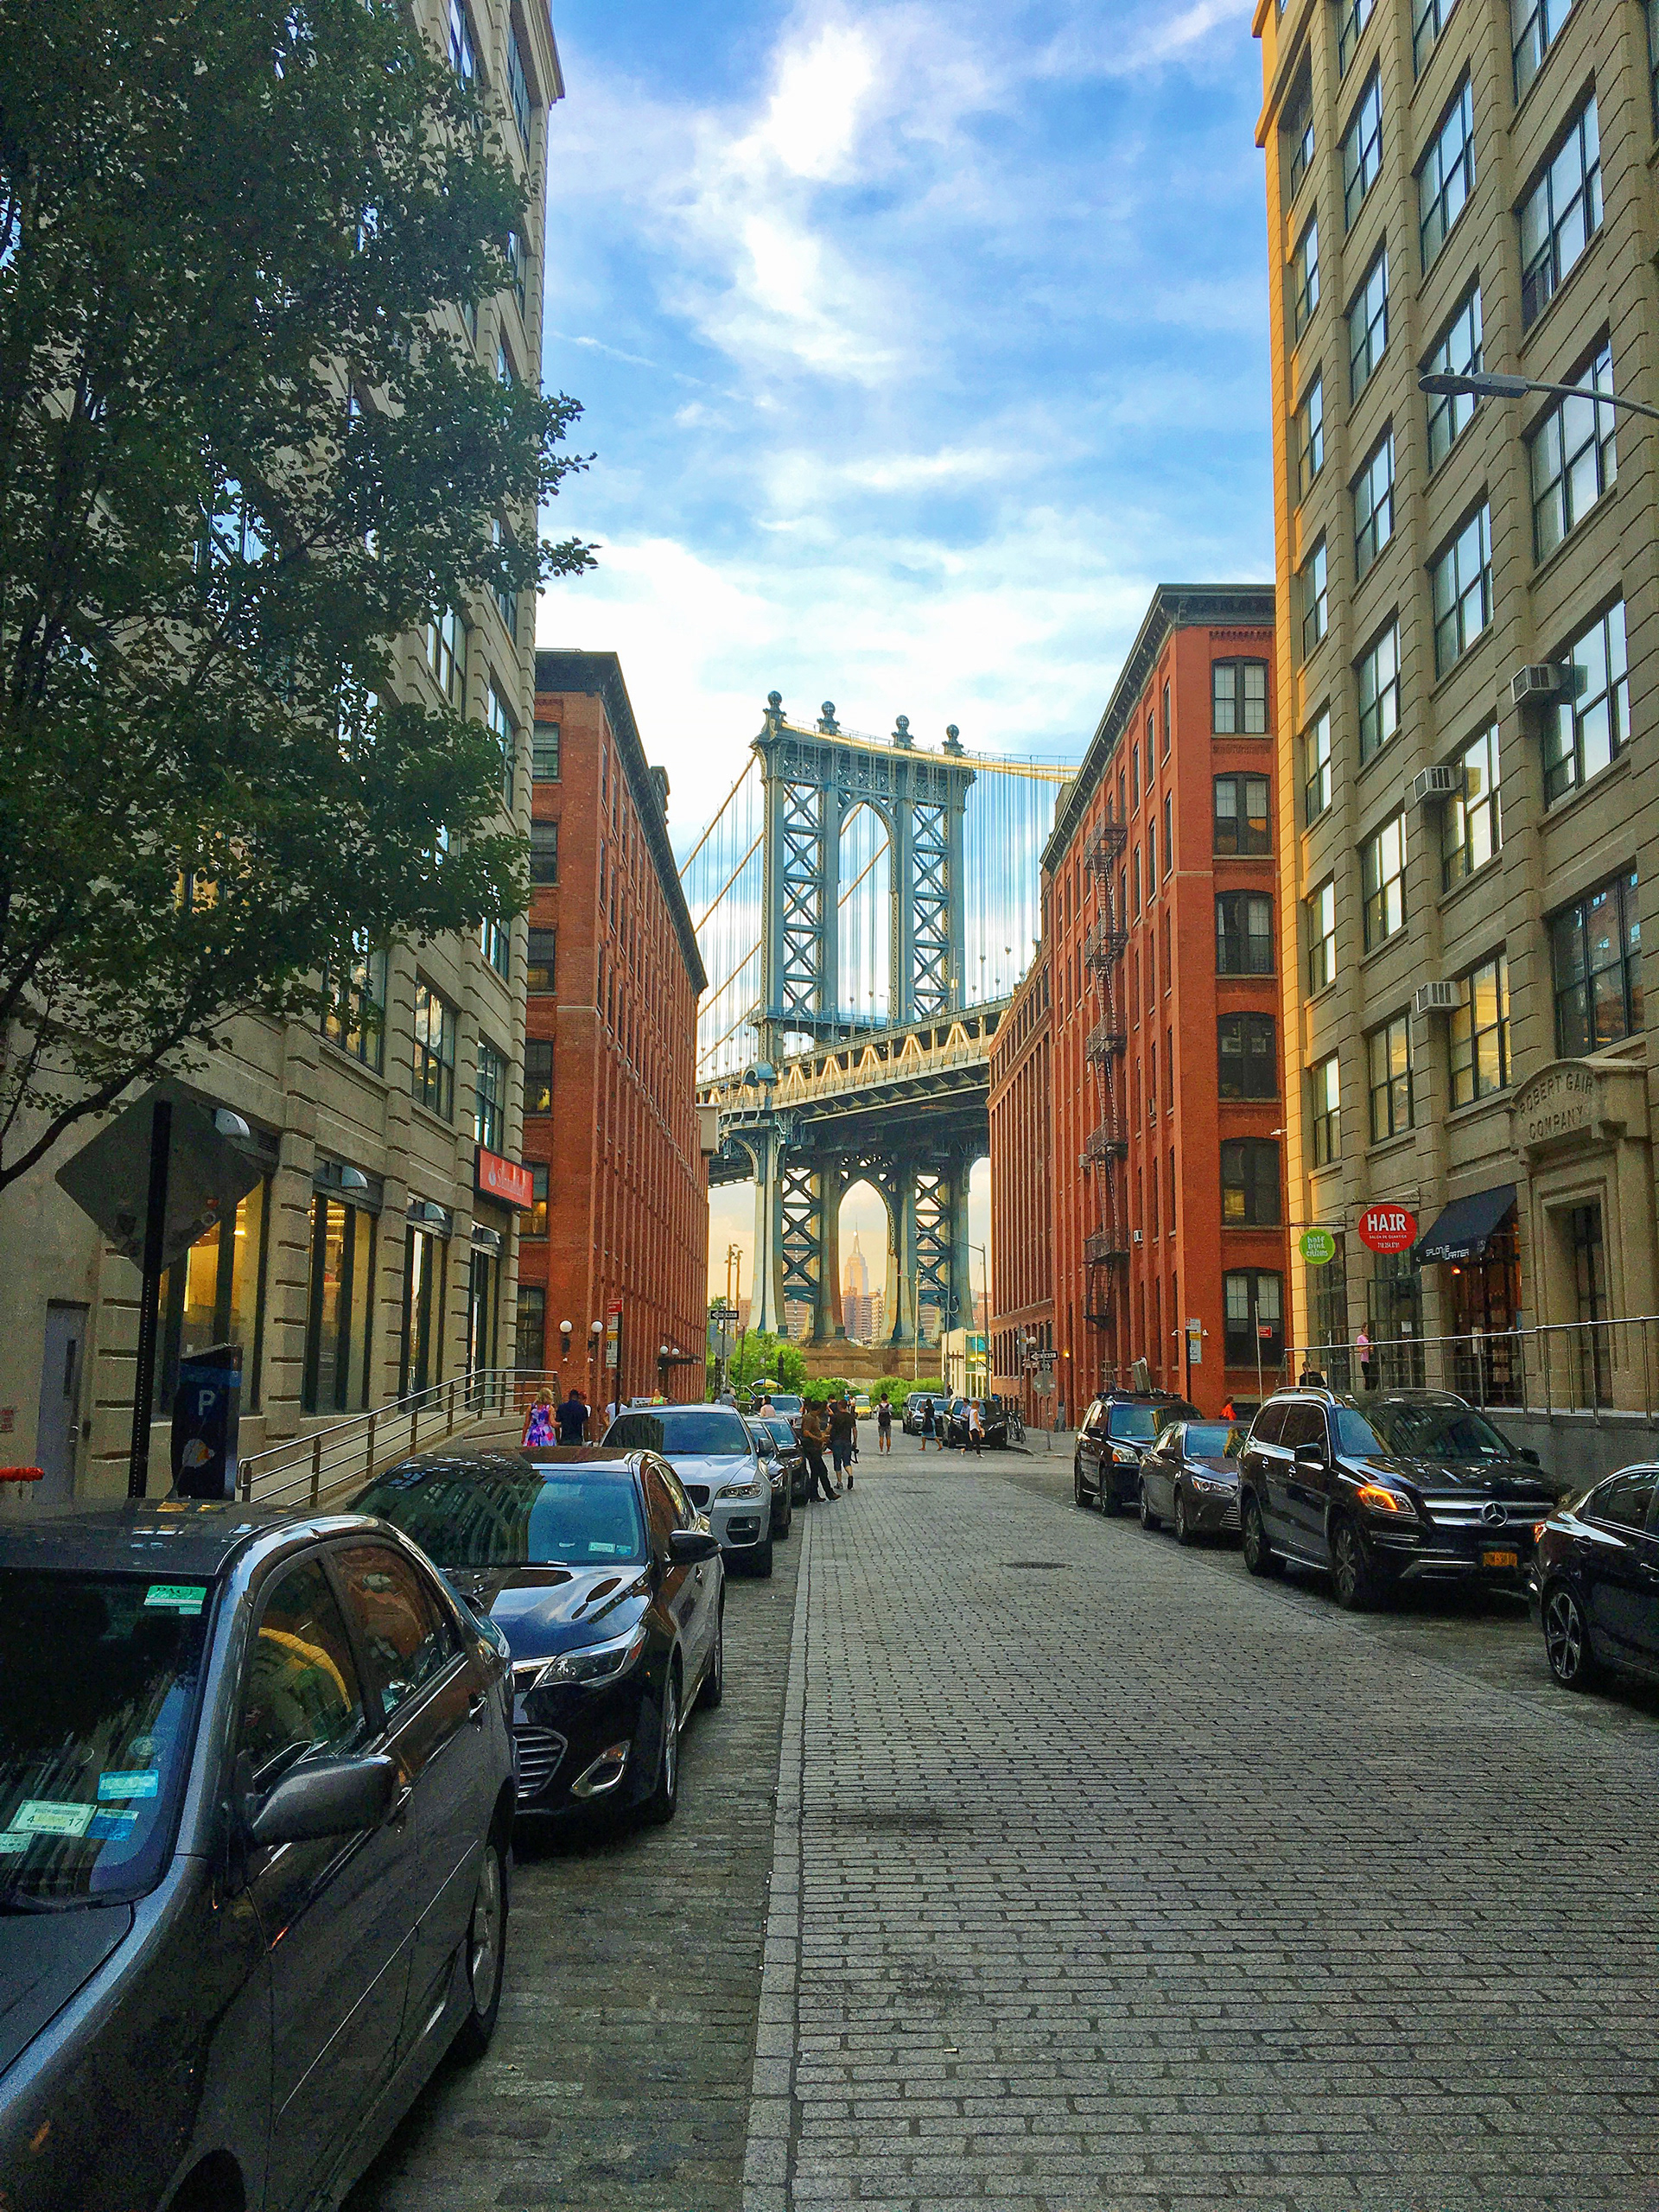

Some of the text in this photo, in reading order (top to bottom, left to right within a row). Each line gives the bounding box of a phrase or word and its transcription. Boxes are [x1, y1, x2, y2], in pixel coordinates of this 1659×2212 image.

[1519, 1073, 1592, 1113] ROBERT GAIR
[1529, 1104, 1583, 1140] COMPANY
[1367, 1213, 1407, 1232] HAIR
[198, 1389, 216, 1416] P
[27, 1815, 35, 1824] 4
[69, 1817, 84, 1827] 17
